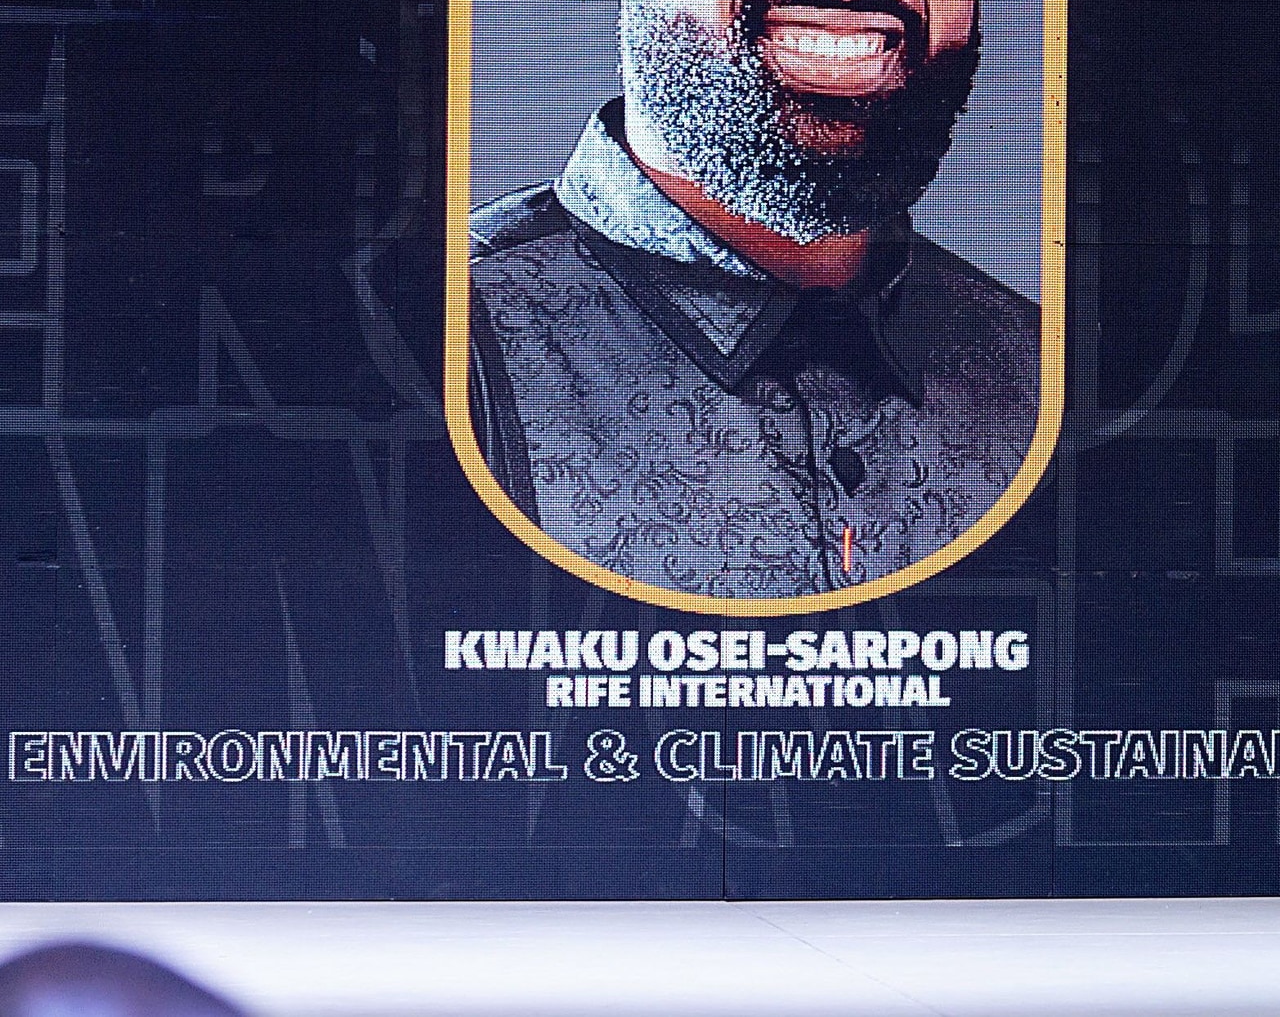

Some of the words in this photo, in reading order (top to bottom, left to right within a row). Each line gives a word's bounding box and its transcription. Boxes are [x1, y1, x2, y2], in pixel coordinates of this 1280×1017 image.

[444, 631, 637, 669] KWAKU
[648, 631, 1029, 671] OSEI-SARPONG
[546, 676, 630, 707] RIFE
[639, 674, 950, 706] INTERNATIONAL
[8, 730, 567, 781] ENVIRONMENTAL
[584, 729, 641, 781] &
[654, 729, 934, 781] CLIMATE
